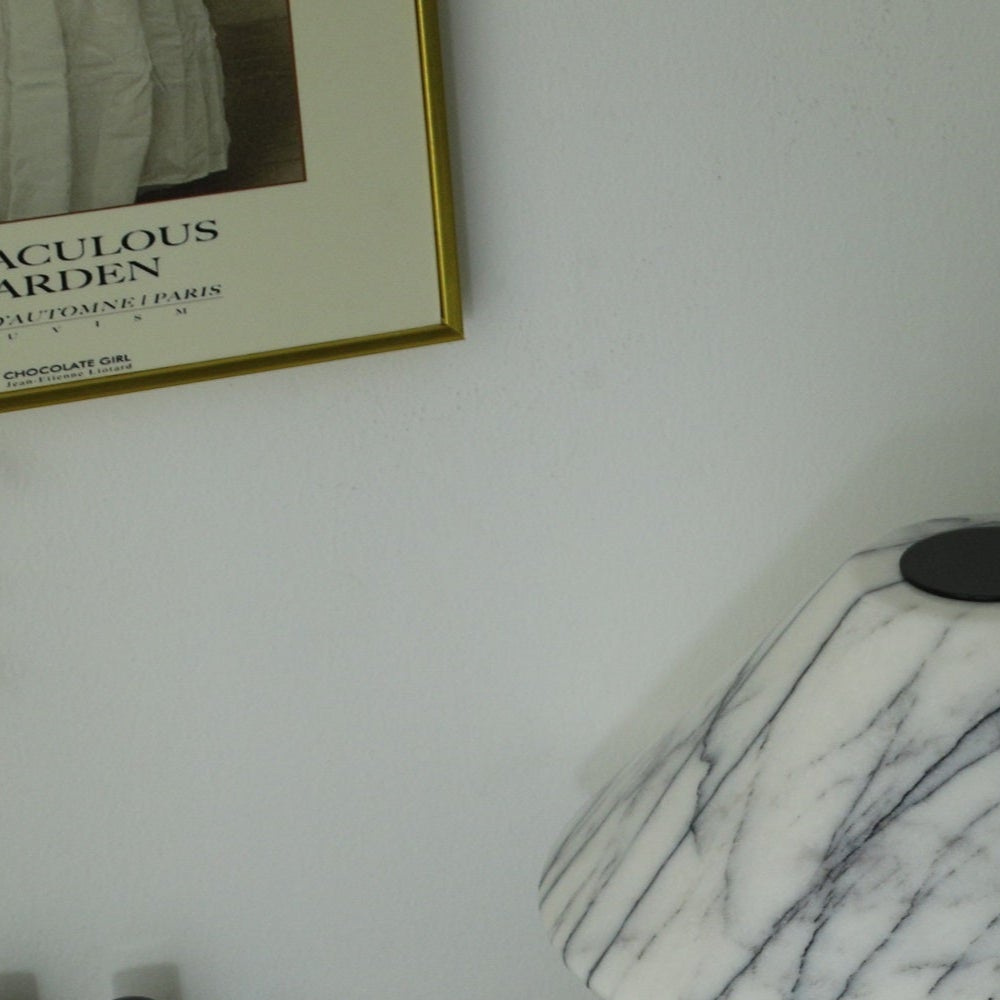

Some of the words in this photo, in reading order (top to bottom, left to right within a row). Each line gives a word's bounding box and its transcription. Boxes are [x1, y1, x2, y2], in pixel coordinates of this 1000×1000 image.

[0, 257, 161, 299] ARDEN
[154, 284, 222, 305] PARIS
[3, 358, 96, 381] CHOCOLATE
[99, 354, 132, 367] GIRL
